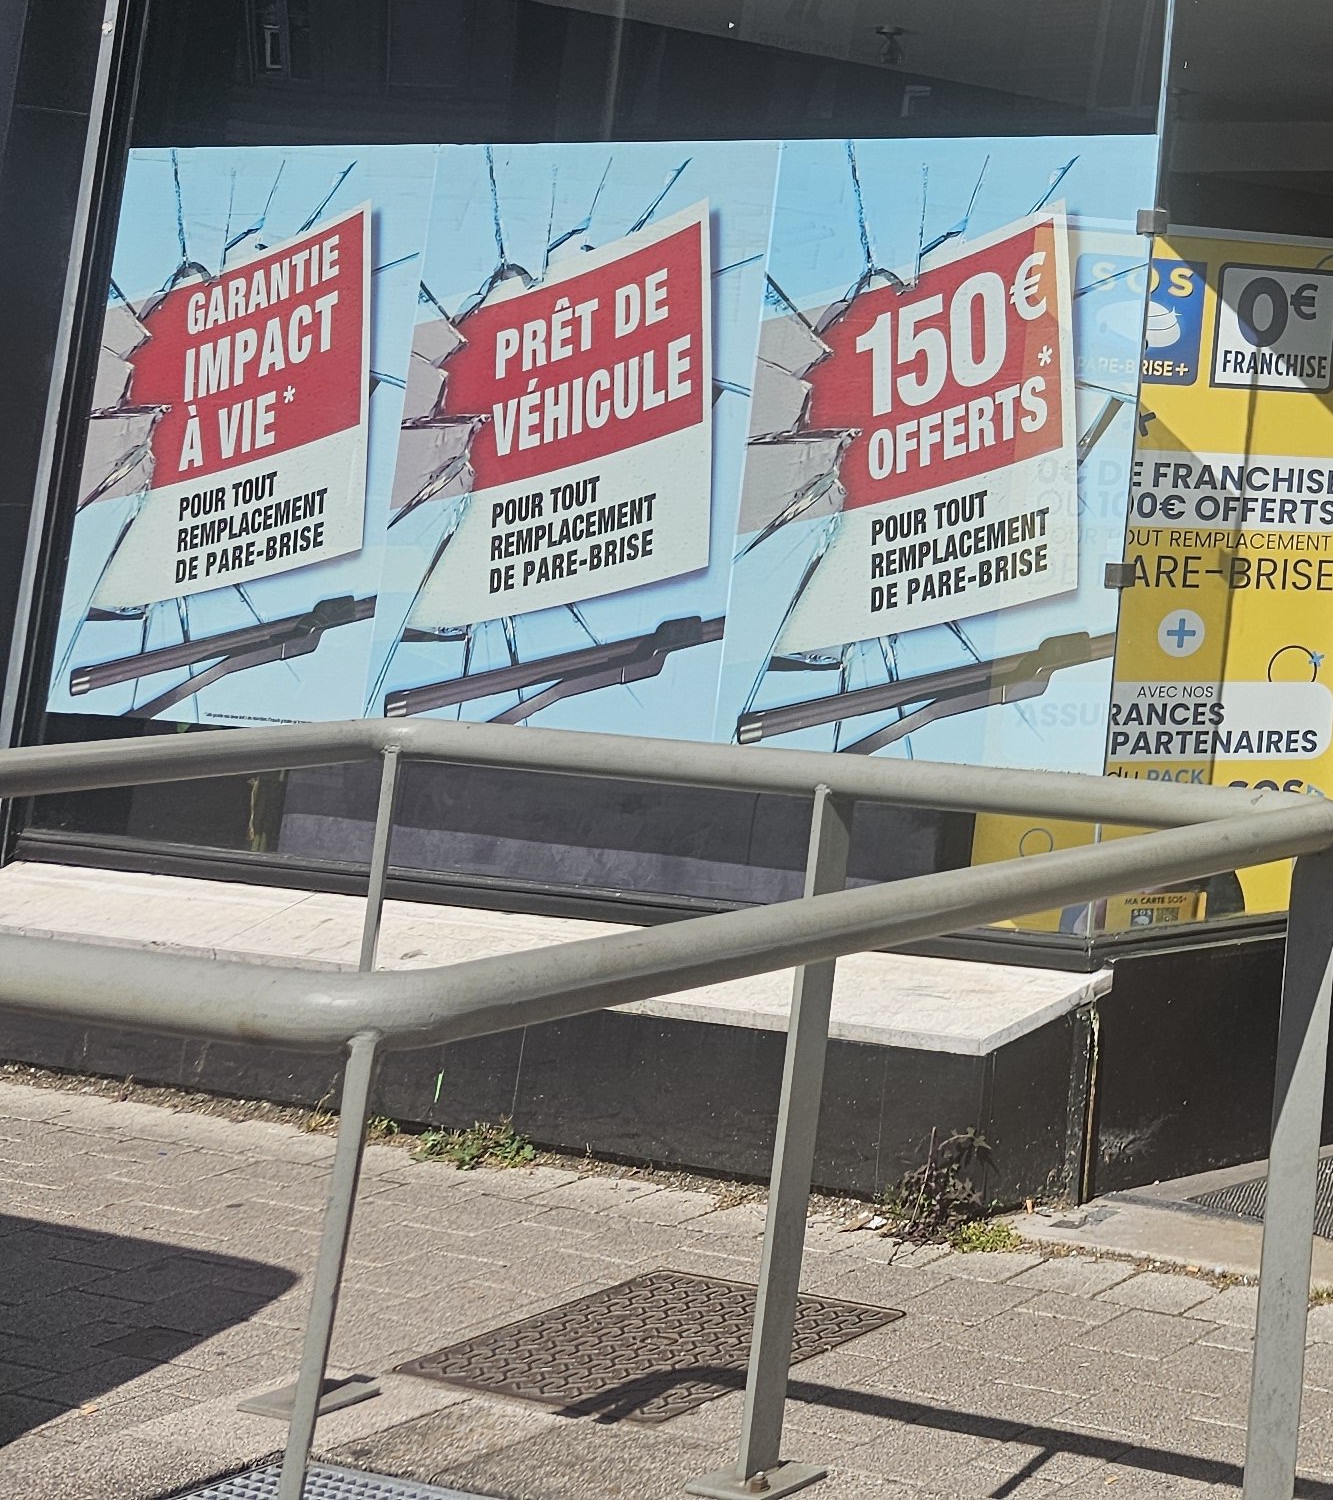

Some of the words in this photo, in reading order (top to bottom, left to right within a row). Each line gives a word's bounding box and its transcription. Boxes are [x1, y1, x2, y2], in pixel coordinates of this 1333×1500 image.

[186, 234, 341, 336] GARANTIE
[1091, 261, 1195, 298] SOS
[183, 291, 340, 404] IMPACT
[494, 296, 599, 380] PRÊT
[614, 268, 670, 339] DE
[855, 251, 1048, 418] 150€
[492, 334, 693, 457] VÉHICULE
[1221, 348, 1328, 381] FRANCHISE
[178, 406, 203, 473] À
[176, 488, 328, 553] REMPLACEMENT
[178, 485, 226, 522] POUR
[232, 470, 278, 505] TOUT
[490, 493, 657, 562] REMPLACEMENT
[491, 492, 543, 529] POUR
[549, 475, 601, 513] TOUT
[870, 509, 928, 546] POUR
[933, 490, 988, 531] TOUT
[174, 554, 199, 584] DE
[205, 521, 325, 578] PARE-BRISE
[489, 564, 516, 594] DE
[522, 528, 654, 587] PARE-BRISE
[869, 507, 1050, 580] REMPLACEMENT
[1169, 529, 1333, 552] REMPLACEMENT
[869, 582, 899, 614] DE
[906, 543, 1049, 606] PARE-BRISE
[1136, 685, 1181, 699] AVEC
[1182, 685, 1214, 699] NOS
[1110, 729, 1319, 756] PARTENAIRES
[1141, 896, 1165, 905] CARTE
